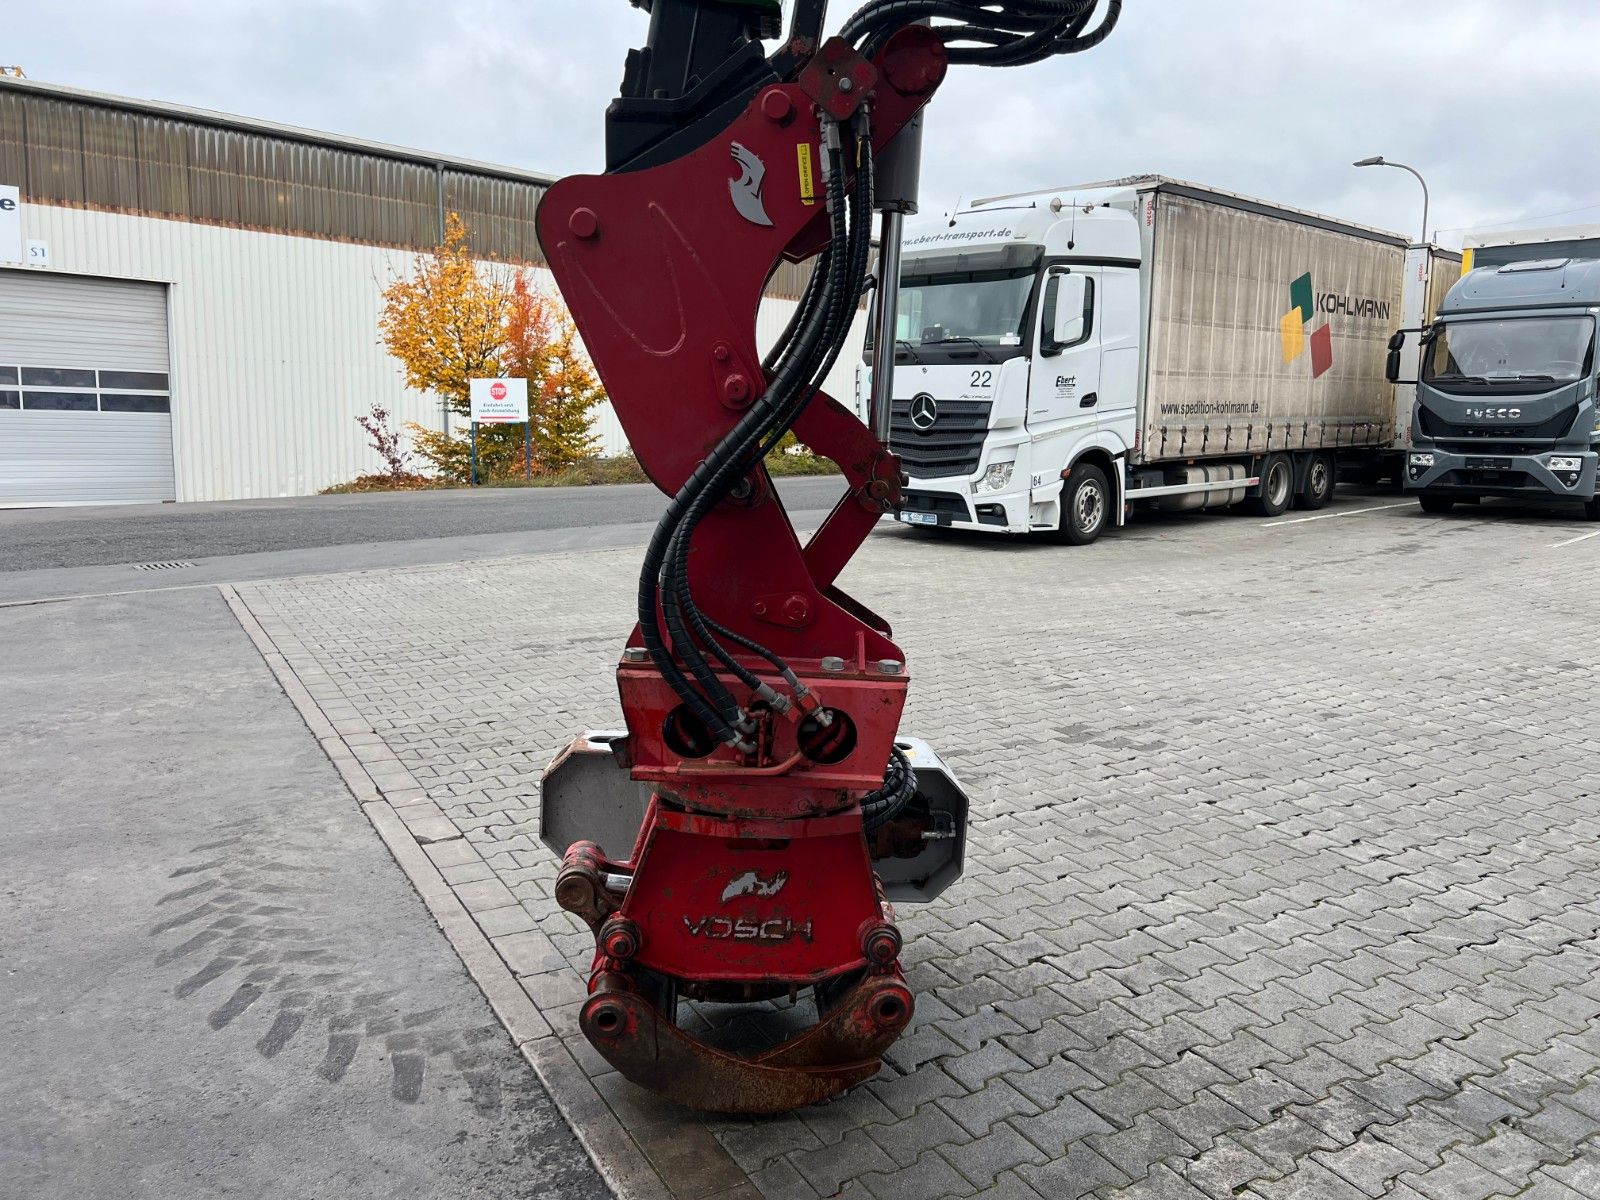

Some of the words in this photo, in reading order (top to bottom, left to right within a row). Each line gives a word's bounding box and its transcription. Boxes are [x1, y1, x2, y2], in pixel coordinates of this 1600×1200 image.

[30, 247, 46, 257] S1
[1316, 292, 1390, 320] KOHLMANN
[970, 370, 992, 387] 22
[1056, 375, 1076, 387] Ebert
[491, 387, 506, 396] STOP
[1161, 400, 1259, 418] www.spedition-kohlmann.de
[1466, 408, 1521, 418] IVECO
[1033, 475, 1041, 486] 64
[683, 916, 813, 940] VOSCH
